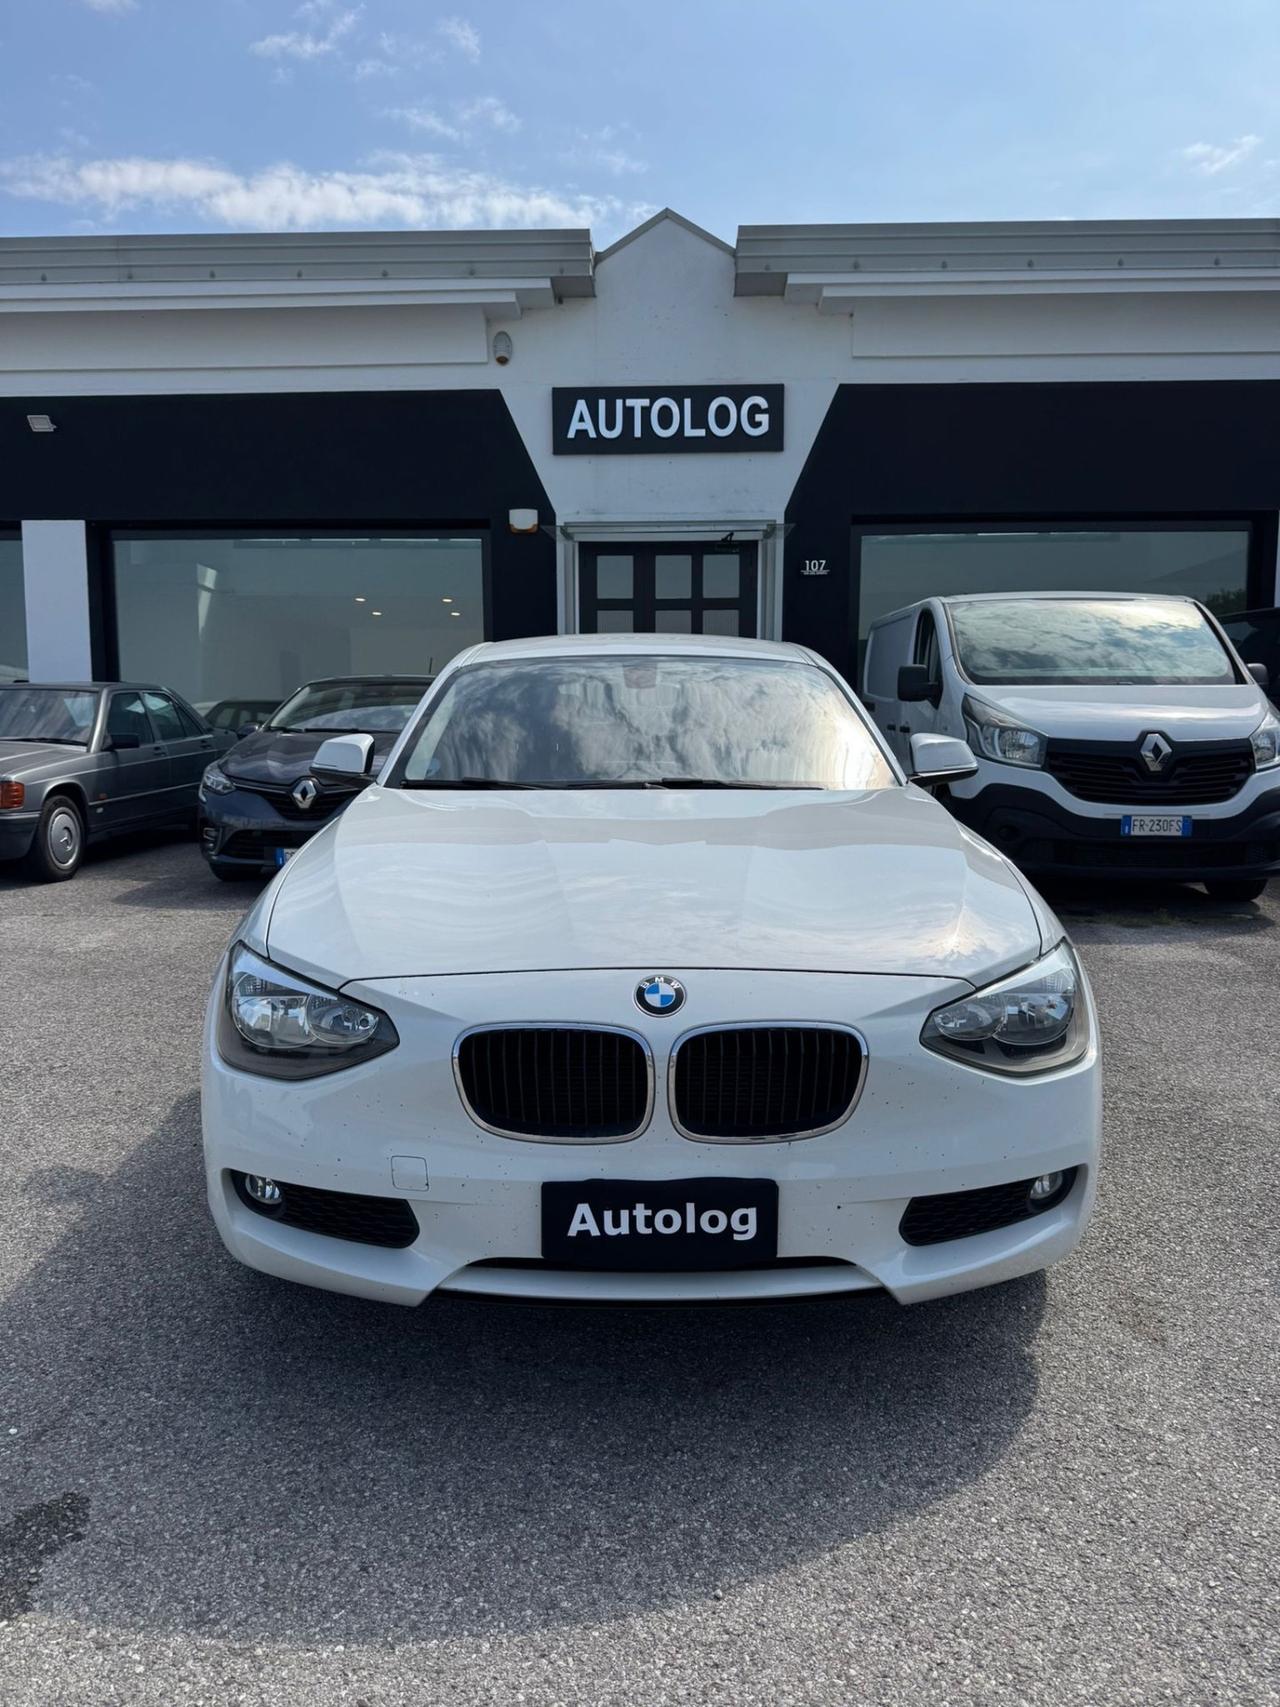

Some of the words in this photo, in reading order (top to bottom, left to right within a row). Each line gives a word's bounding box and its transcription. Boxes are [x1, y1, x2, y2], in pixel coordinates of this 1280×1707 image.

[566, 395, 770, 439] AUTOLOG
[804, 559, 827, 571] 107
[640, 976, 681, 989] BMW
[567, 1202, 757, 1241] Autolog
